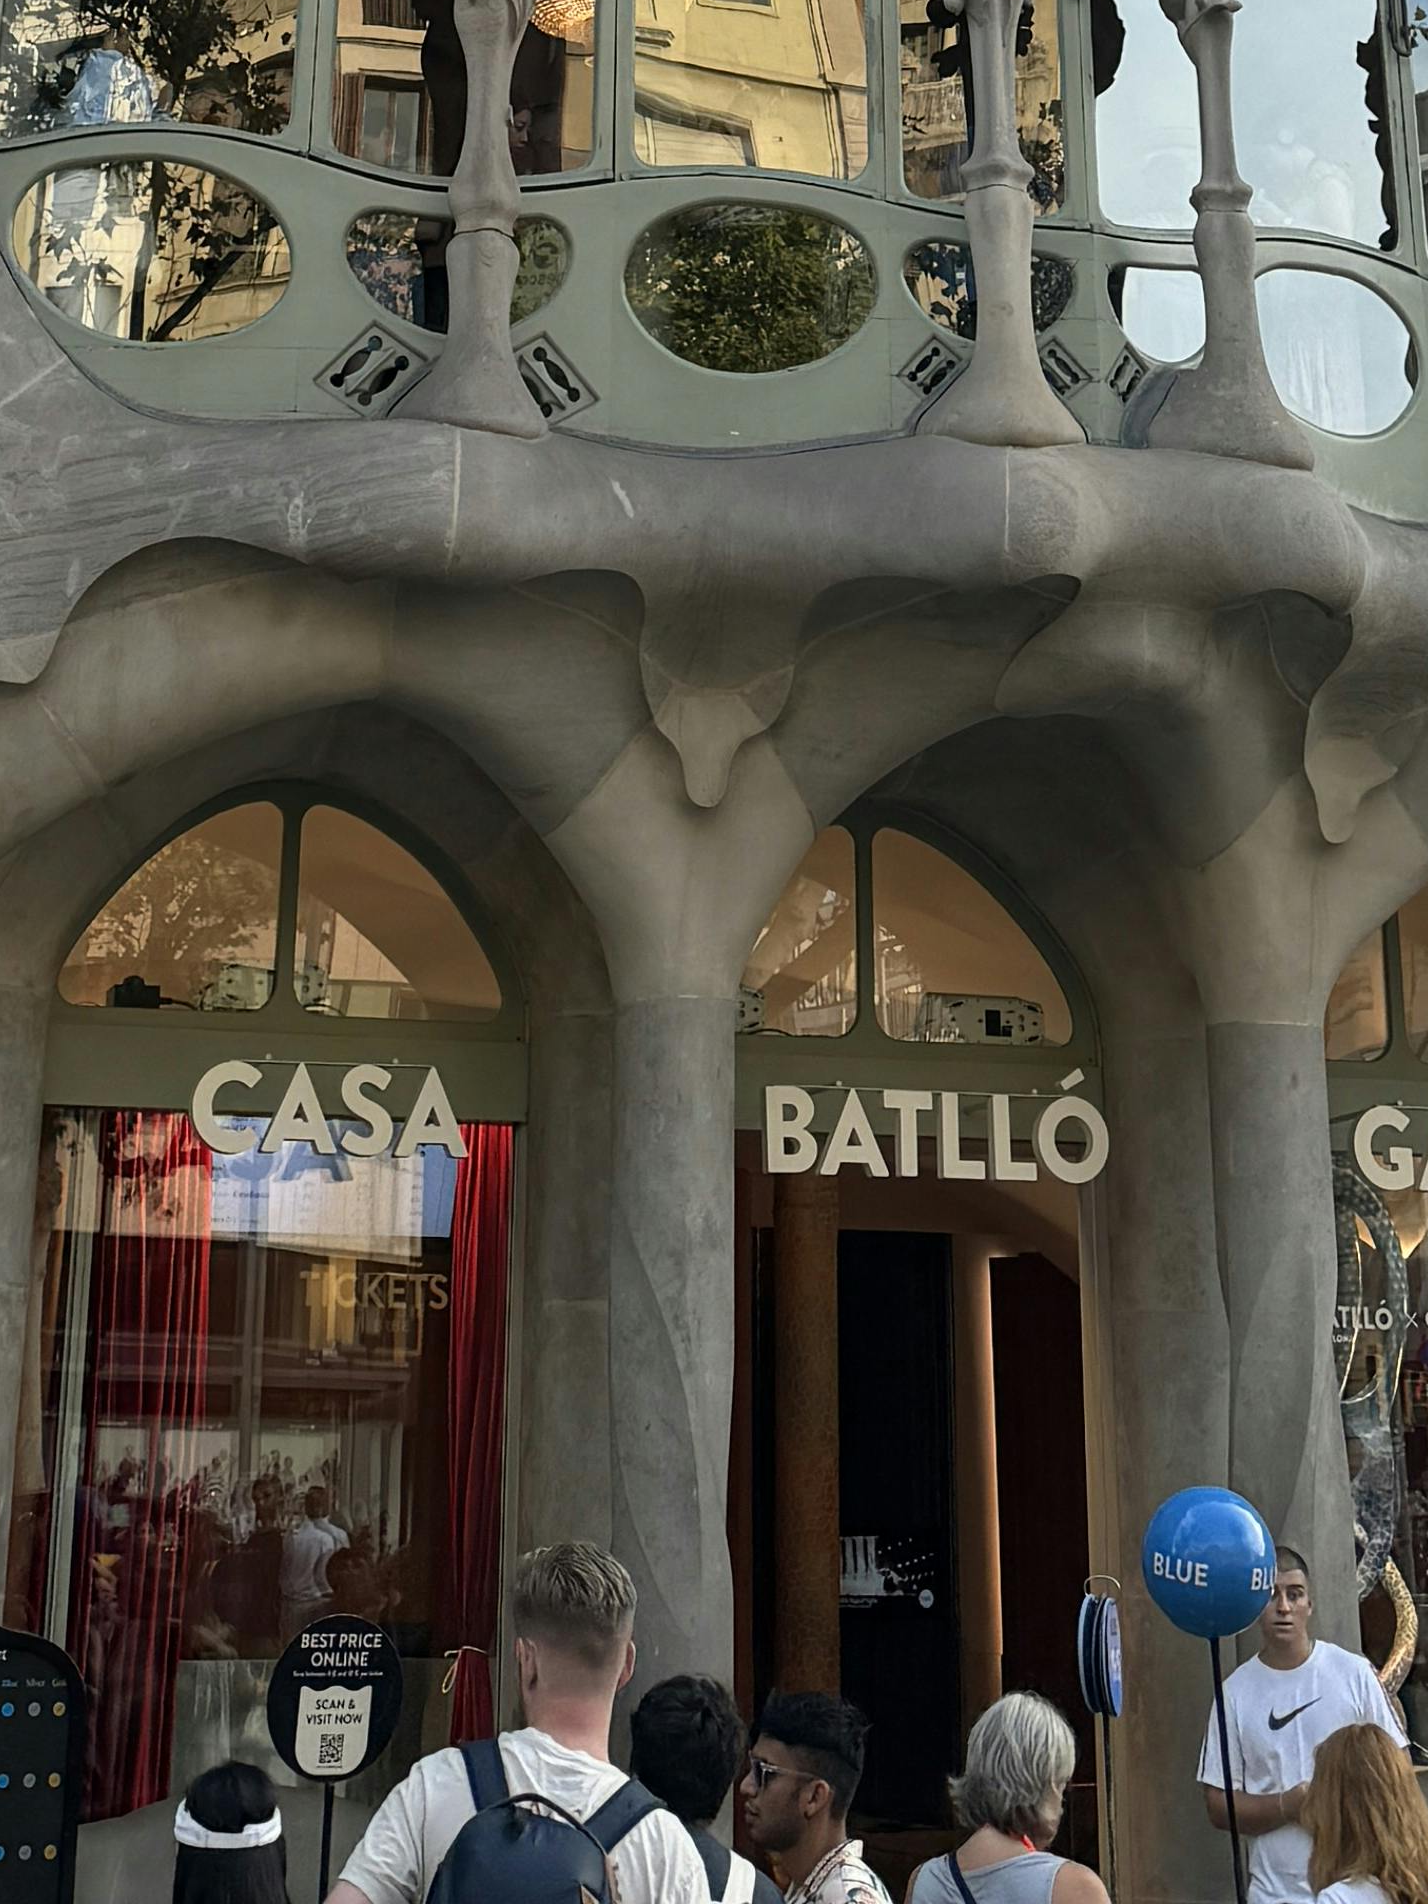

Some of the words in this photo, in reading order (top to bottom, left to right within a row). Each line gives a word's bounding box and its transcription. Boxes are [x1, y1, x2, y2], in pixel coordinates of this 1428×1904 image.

[191, 1060, 469, 1159] CASA
[764, 1067, 1110, 1185] BATLLÓ
[299, 1270, 449, 1311] TICKETS
[1153, 1551, 1209, 1588] BLUE
[301, 1633, 337, 1649] BEST
[338, 1633, 383, 1648] PRICE
[311, 1652, 369, 1667] ONLINE
[315, 1699, 345, 1710] SCAN
[347, 1699, 356, 1710] &
[306, 1713, 332, 1725] VISIT
[334, 1713, 363, 1724] NOW
